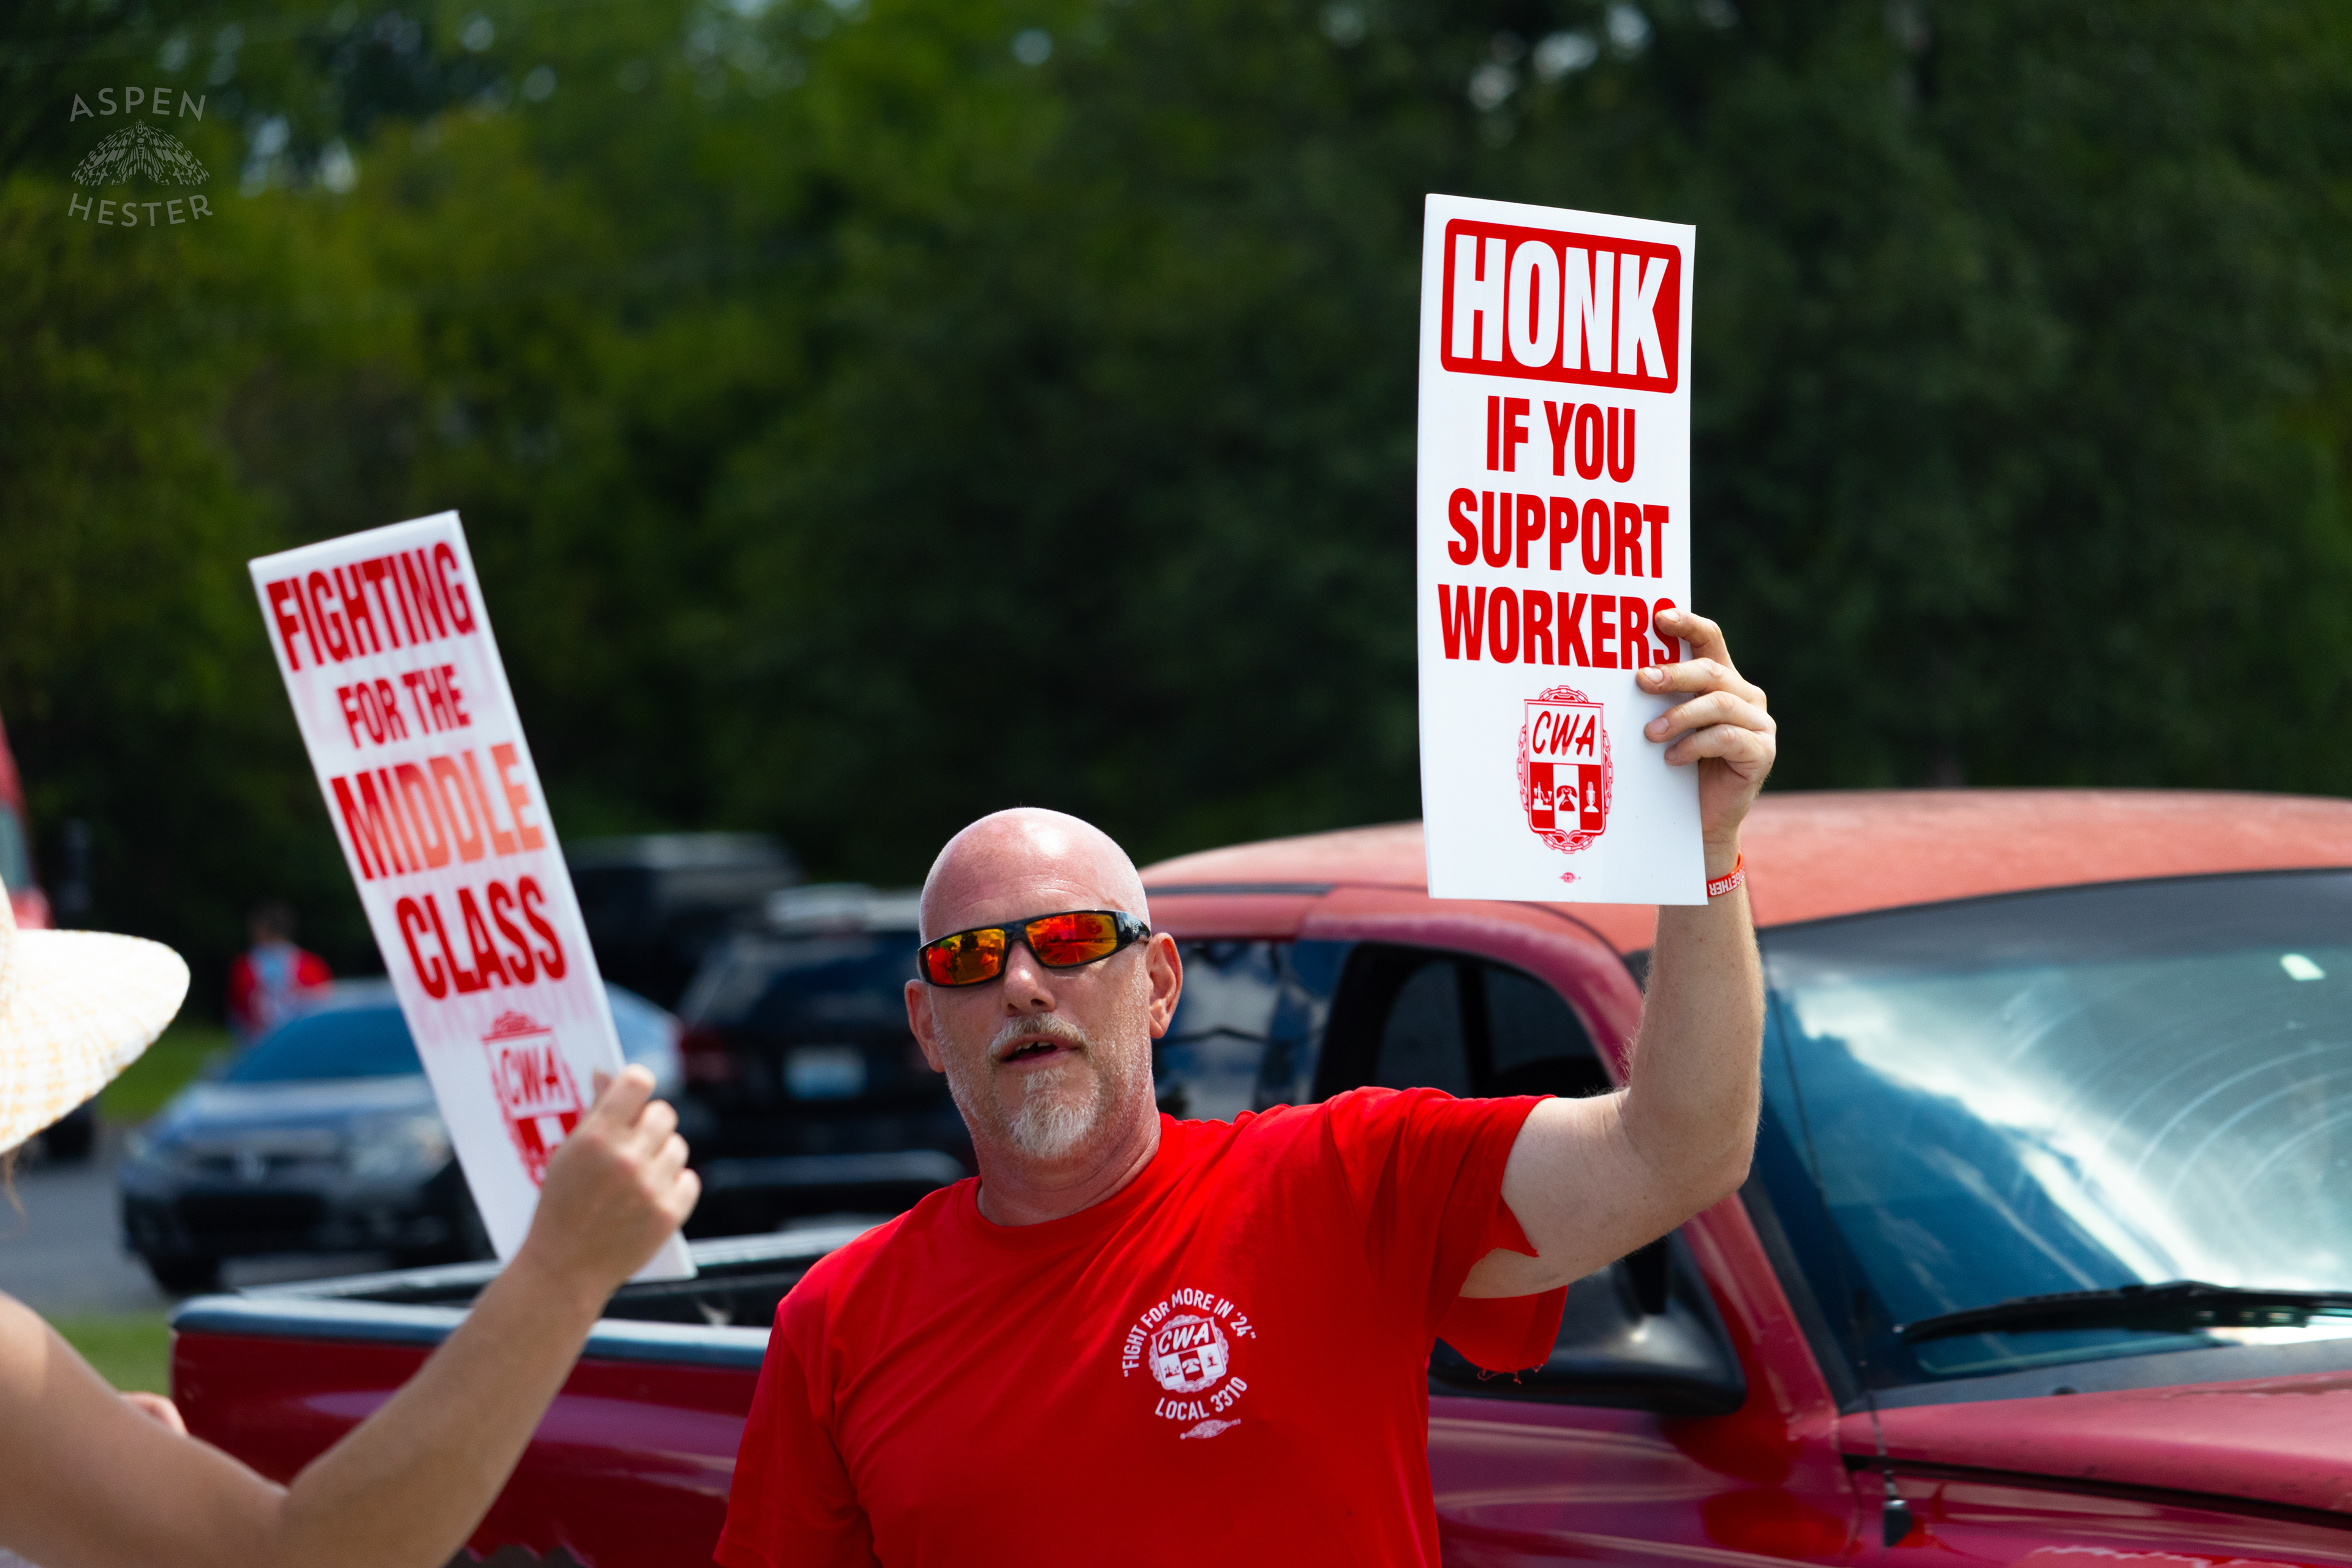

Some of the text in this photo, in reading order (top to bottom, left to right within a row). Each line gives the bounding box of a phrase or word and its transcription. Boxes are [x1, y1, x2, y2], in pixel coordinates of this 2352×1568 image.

[1452, 234, 1669, 379] HONK
[1487, 395, 1635, 483] IF YOU
[1447, 488, 1669, 578] SUPPORT
[266, 541, 477, 673] FIGHTING
[1438, 584, 1681, 669] WORKERS
[336, 664, 471, 749] FOR THE
[1532, 710, 1596, 757] CWA
[330, 742, 546, 881] MIDDLE
[395, 876, 567, 1000] CLASS
[499, 1043, 565, 1105] CWA
[1140, 1301, 1170, 1329] FOR
[1171, 1287, 1215, 1311] MORE
[1213, 1298, 1234, 1319] IN
[1158, 1322, 1209, 1354] CWA
[1155, 1376, 1248, 1421] LOCAL 3310
